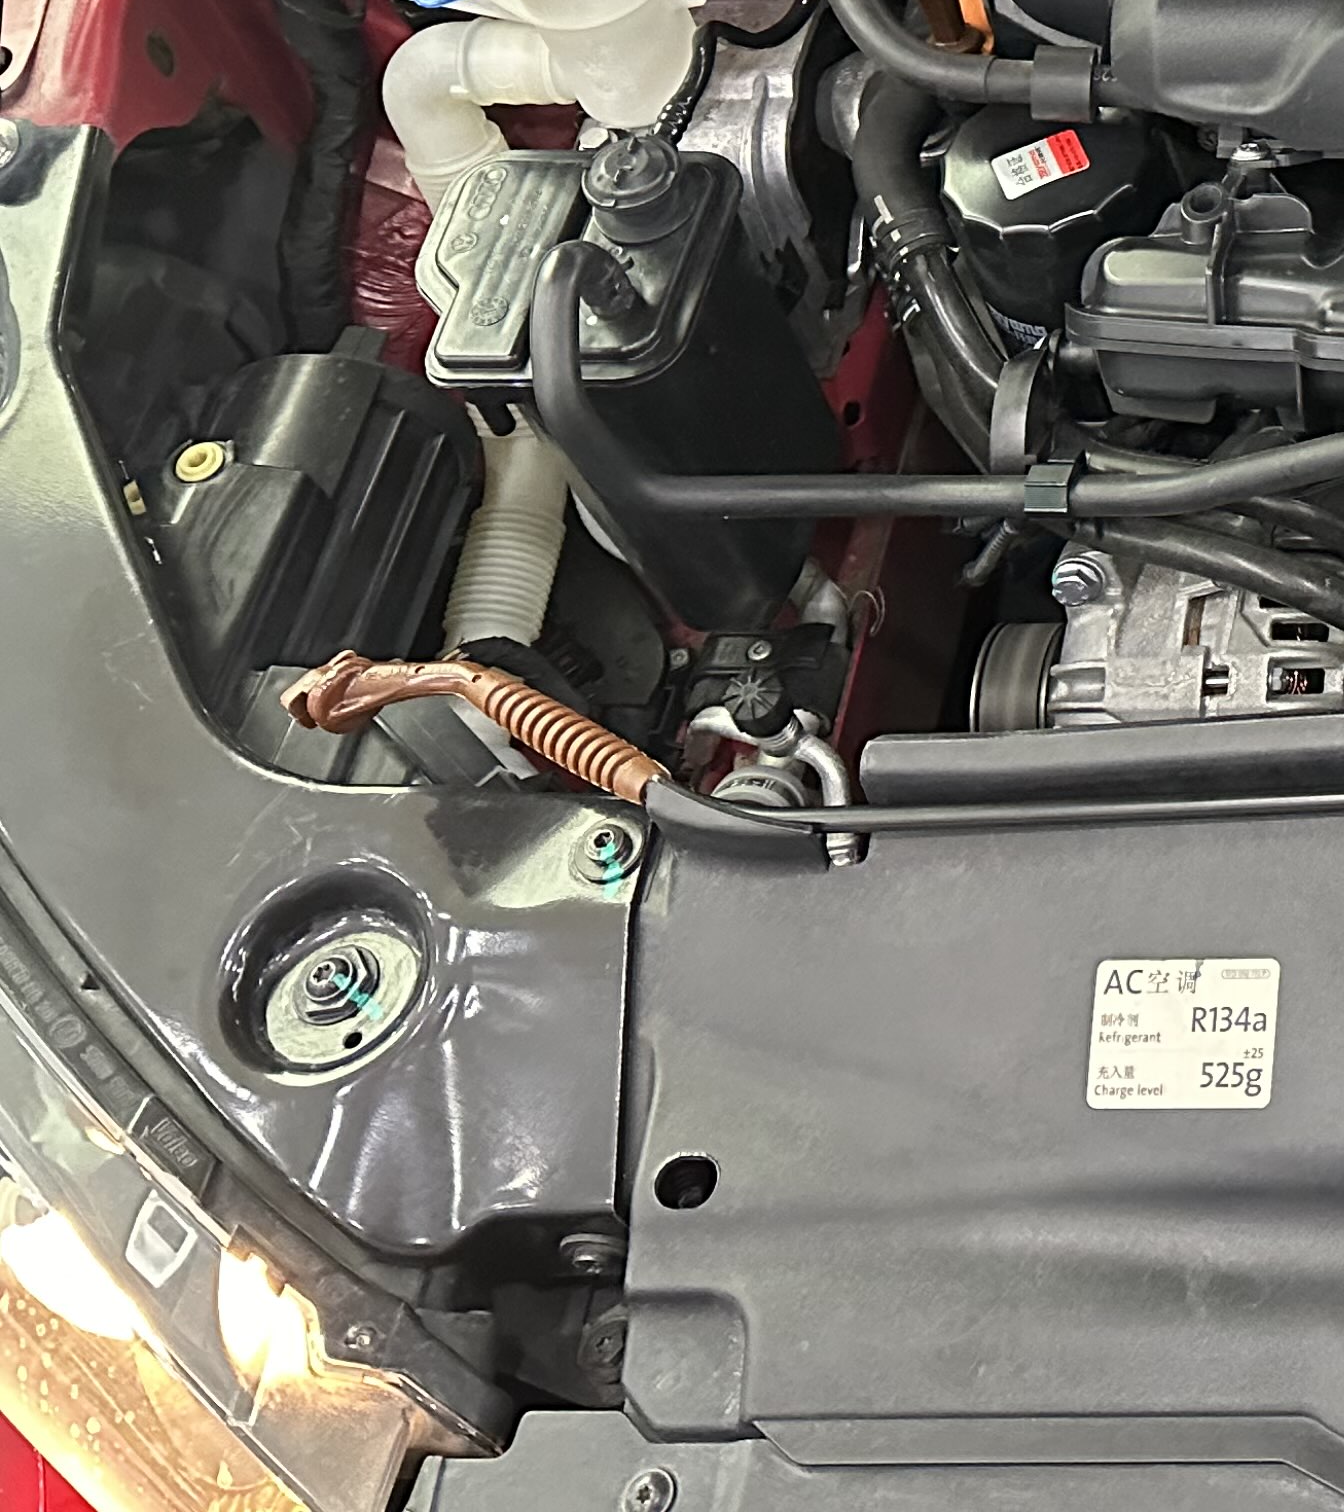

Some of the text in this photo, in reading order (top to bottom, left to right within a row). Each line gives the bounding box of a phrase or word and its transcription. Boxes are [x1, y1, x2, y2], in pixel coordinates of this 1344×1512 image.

[1191, 1006, 1267, 1033] R134a
[1242, 1047, 1264, 1059] ±25
[1096, 1065, 1135, 1080] 充入量
[1199, 1061, 1264, 1097] 525g
[1093, 1083, 1163, 1100] Charge level
